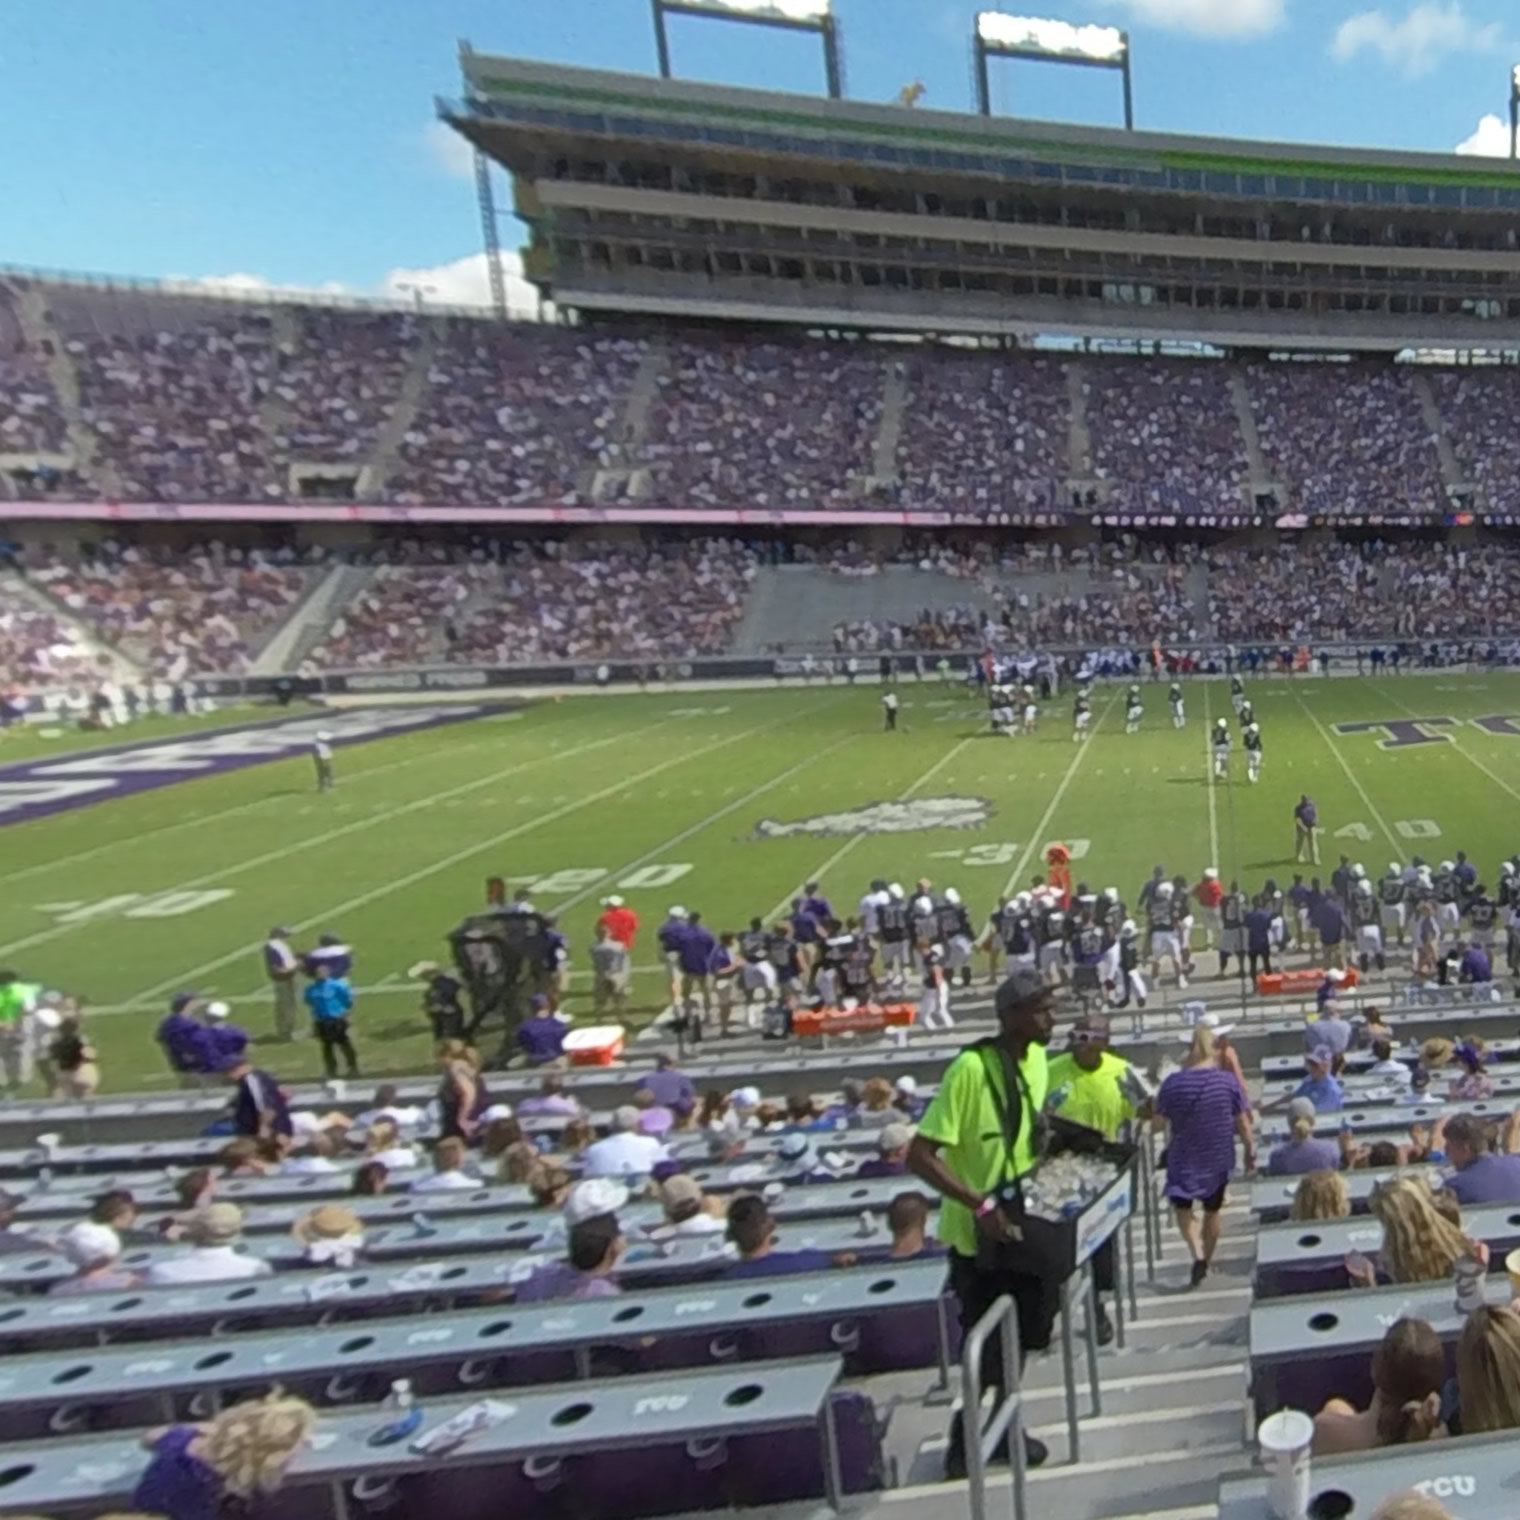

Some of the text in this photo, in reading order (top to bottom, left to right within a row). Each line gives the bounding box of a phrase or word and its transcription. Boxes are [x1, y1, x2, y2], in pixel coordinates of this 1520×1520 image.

[1334, 819, 1443, 842] 40
[962, 838, 1091, 867] 30
[527, 862, 694, 894] 20
[54, 887, 237, 924] 10
[1347, 1229, 1381, 1243] TCU
[633, 1395, 689, 1416] TCU
[1412, 1475, 1476, 1500] TCU
